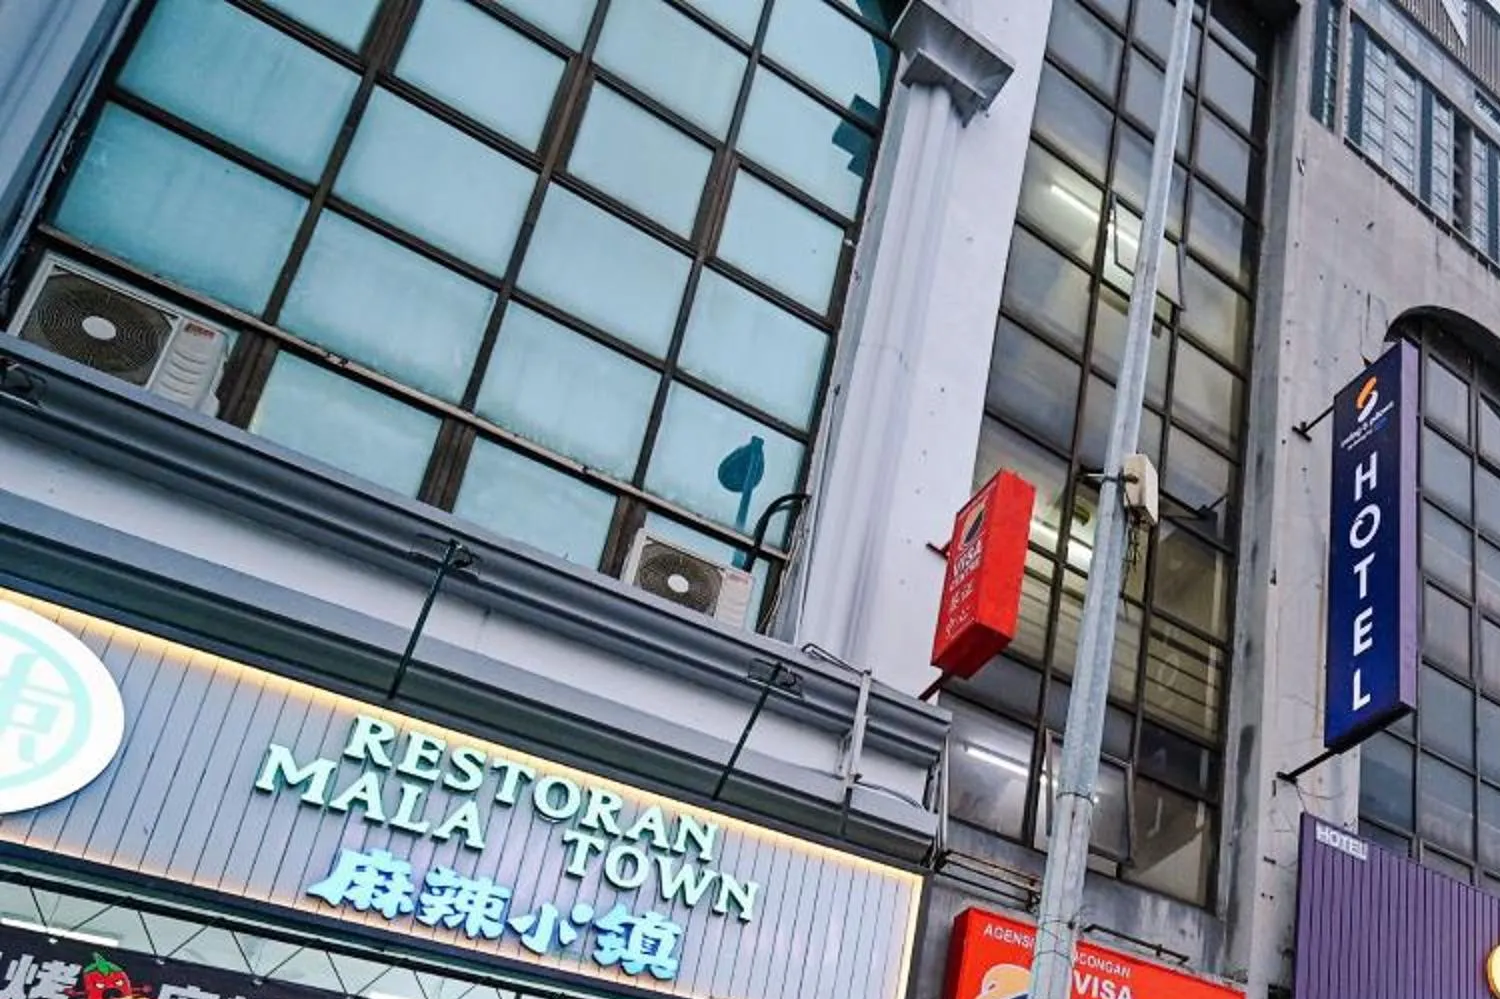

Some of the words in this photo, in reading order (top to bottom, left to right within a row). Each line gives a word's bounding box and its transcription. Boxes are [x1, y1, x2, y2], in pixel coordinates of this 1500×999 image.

[1348, 451, 1380, 711] HOTEL
[256, 744, 487, 850] MALA
[563, 829, 760, 923] TOWN
[345, 715, 720, 861] RESTORAN
[1316, 825, 1368, 861] HOTEL
[306, 847, 685, 981] 麻辣小镇
